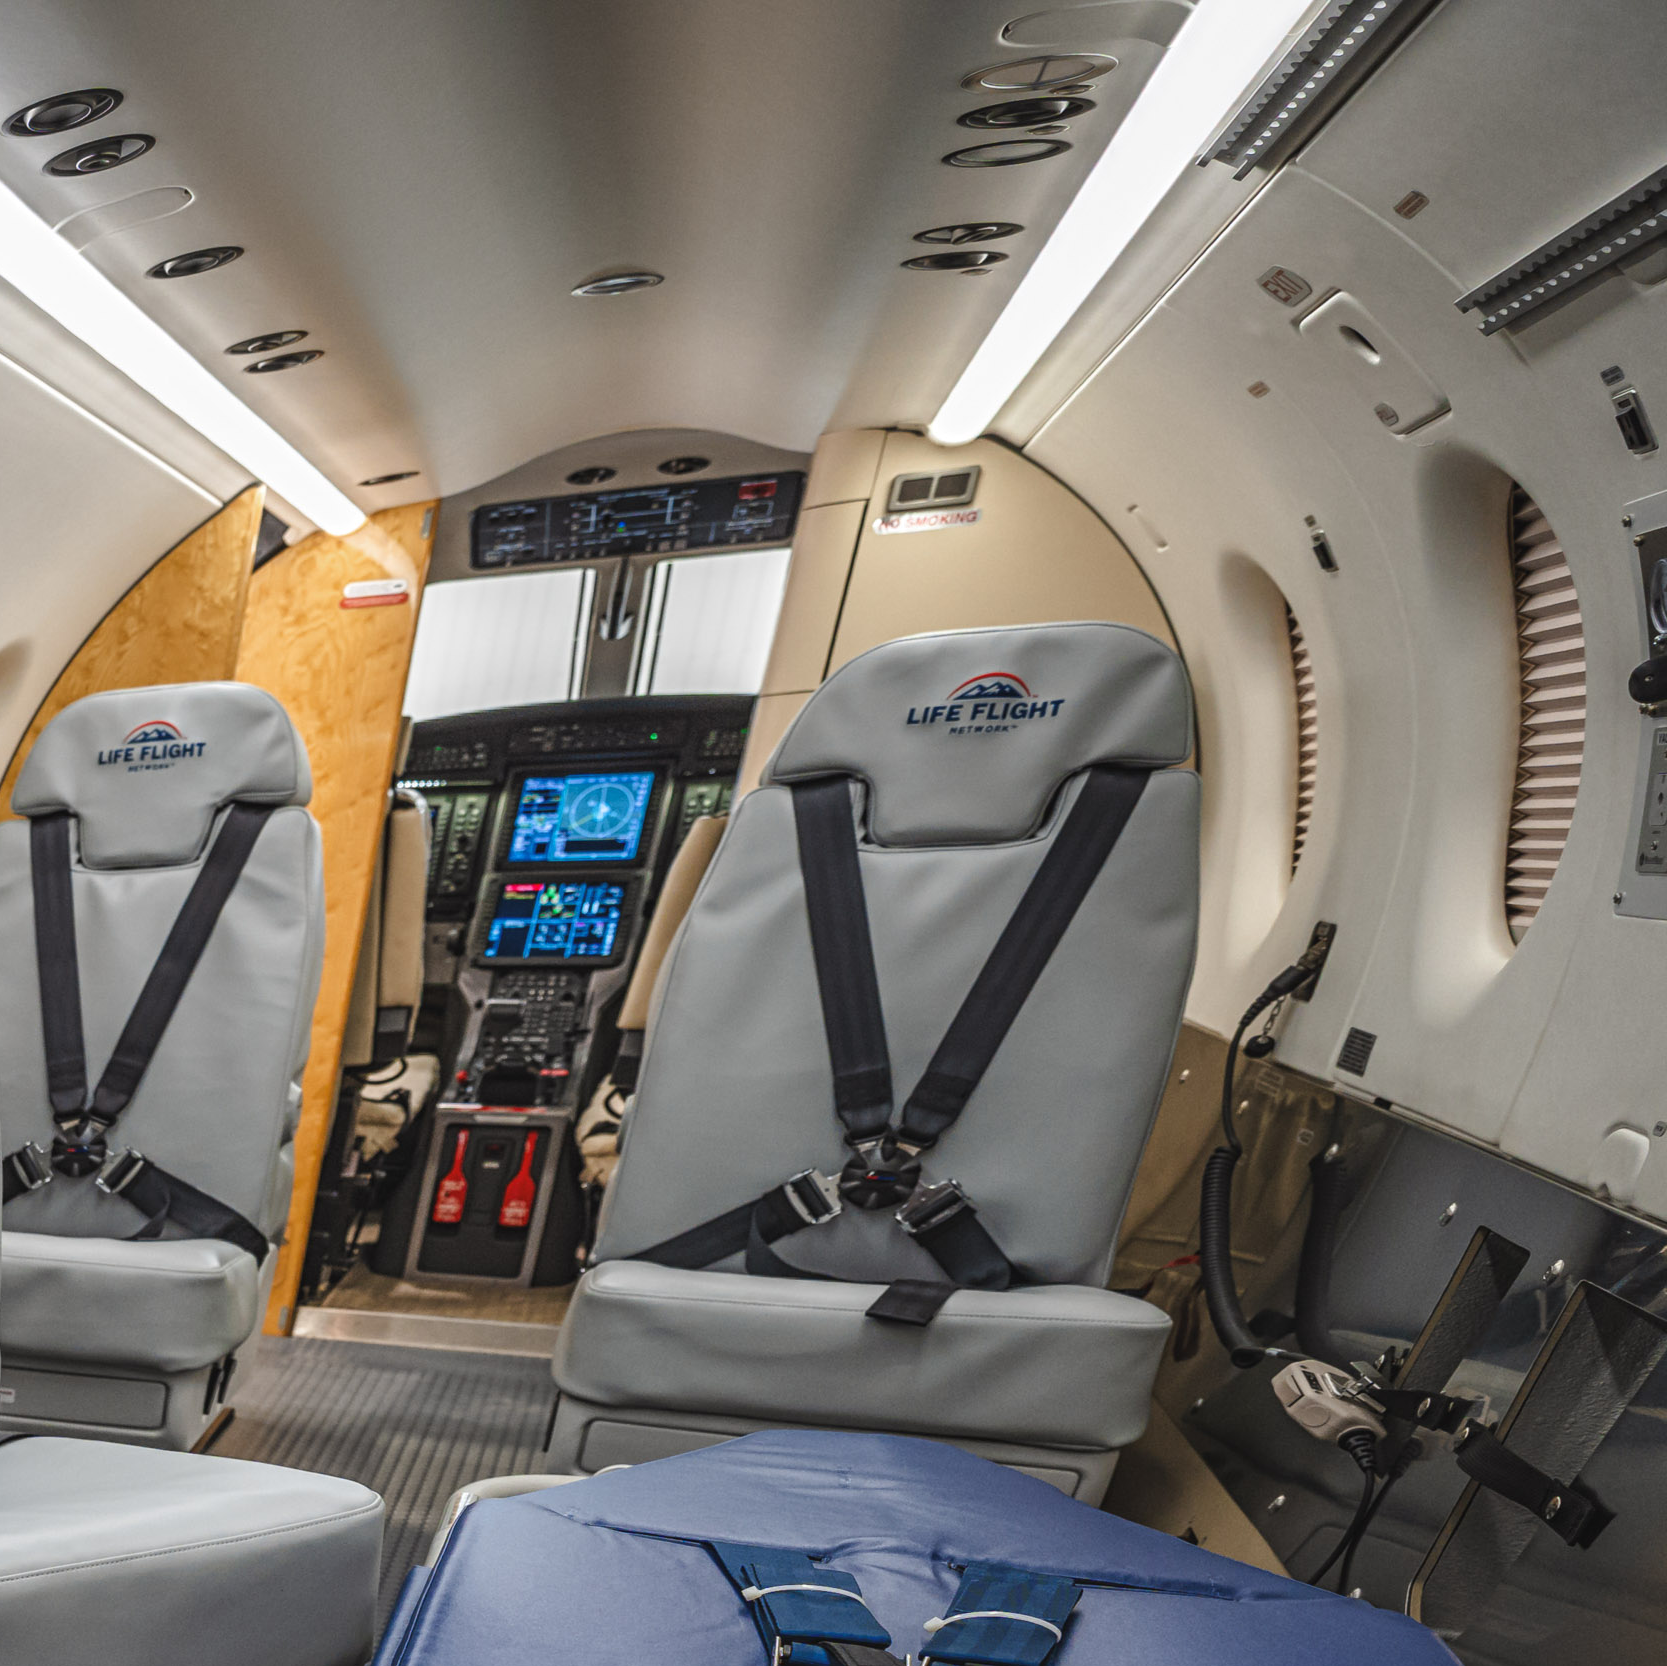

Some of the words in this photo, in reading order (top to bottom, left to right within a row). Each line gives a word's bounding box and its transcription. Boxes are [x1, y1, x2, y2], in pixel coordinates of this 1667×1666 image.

[1261, 269, 1303, 302] EXIT
[878, 517, 900, 531] NO
[906, 510, 978, 528] SMOKING
[906, 704, 964, 726] LIFE
[970, 699, 1065, 721] FLIGHT
[949, 724, 1010, 735] NETWORK
[98, 746, 134, 766] LIFE
[139, 742, 207, 761] FLIGHT
